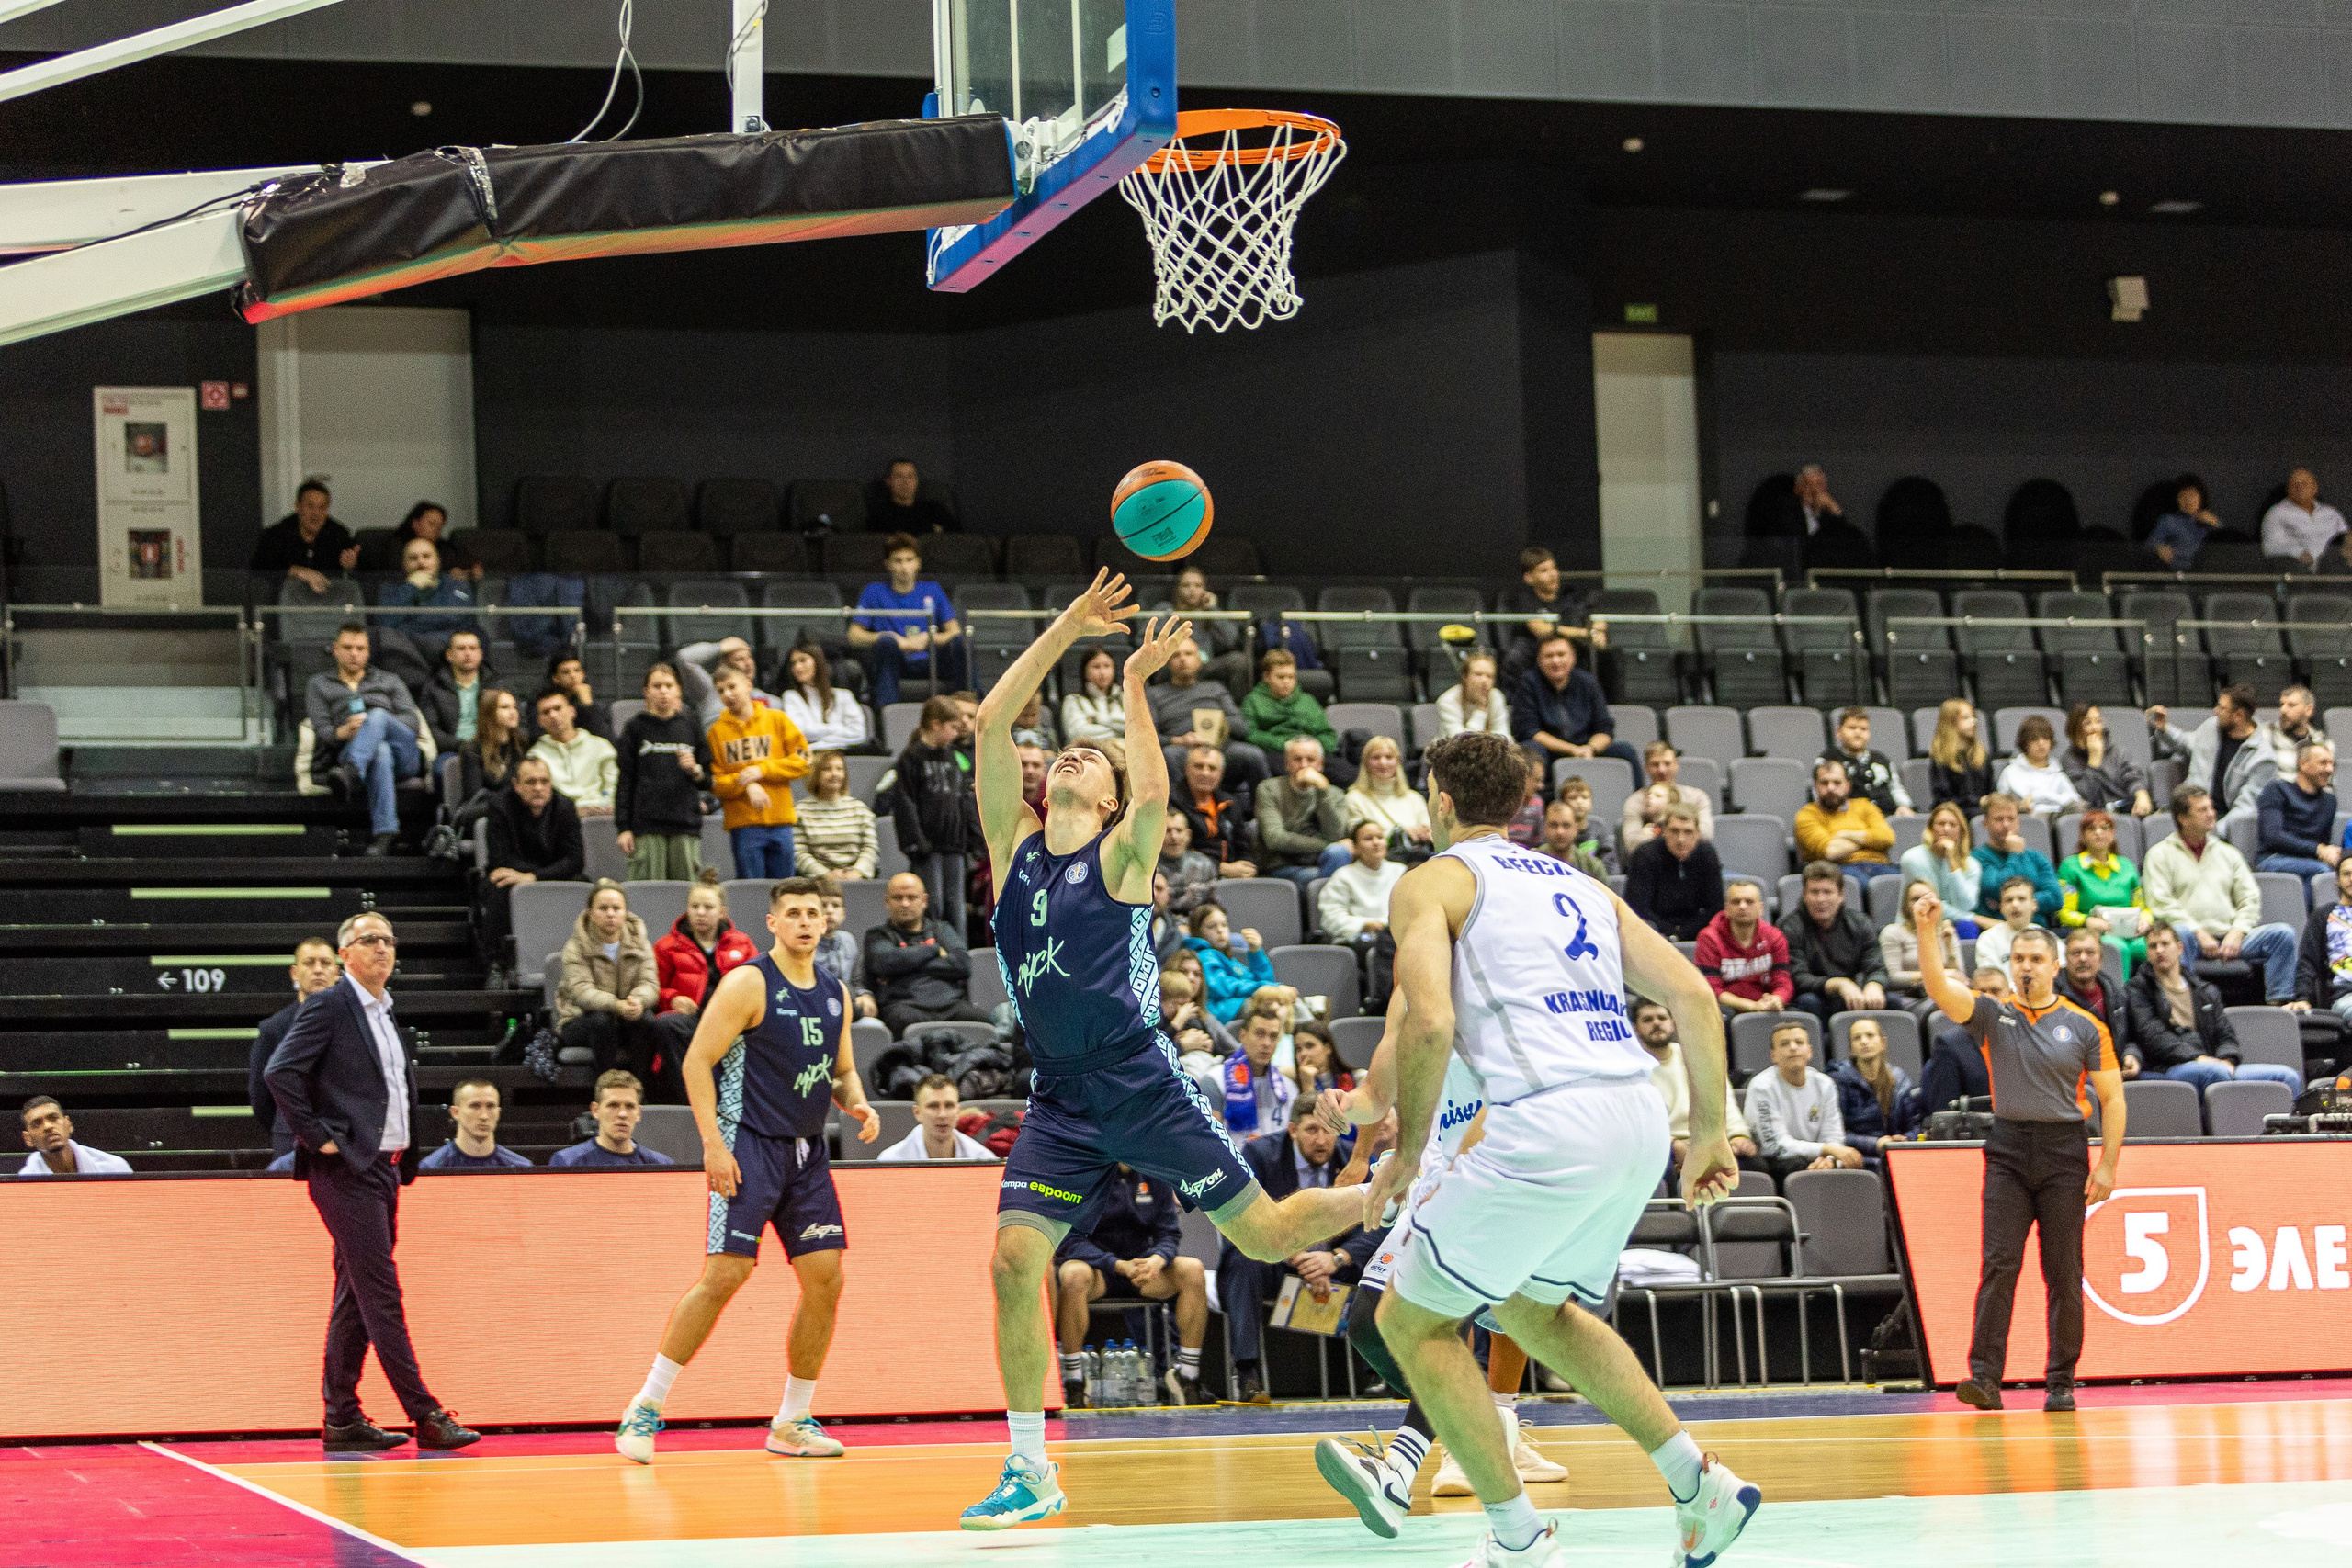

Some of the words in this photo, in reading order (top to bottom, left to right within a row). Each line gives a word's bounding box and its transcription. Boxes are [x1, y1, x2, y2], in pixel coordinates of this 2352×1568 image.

[725, 736, 771, 763] NEW
[1030, 889, 1048, 927] 9
[1552, 892, 1599, 961] 2
[181, 968, 227, 993] 109
[799, 1016, 824, 1046] 15
[1272, 1106, 1283, 1126] 4
[1029, 1181, 1083, 1205] евроопт
[2120, 1211, 2169, 1294] 5
